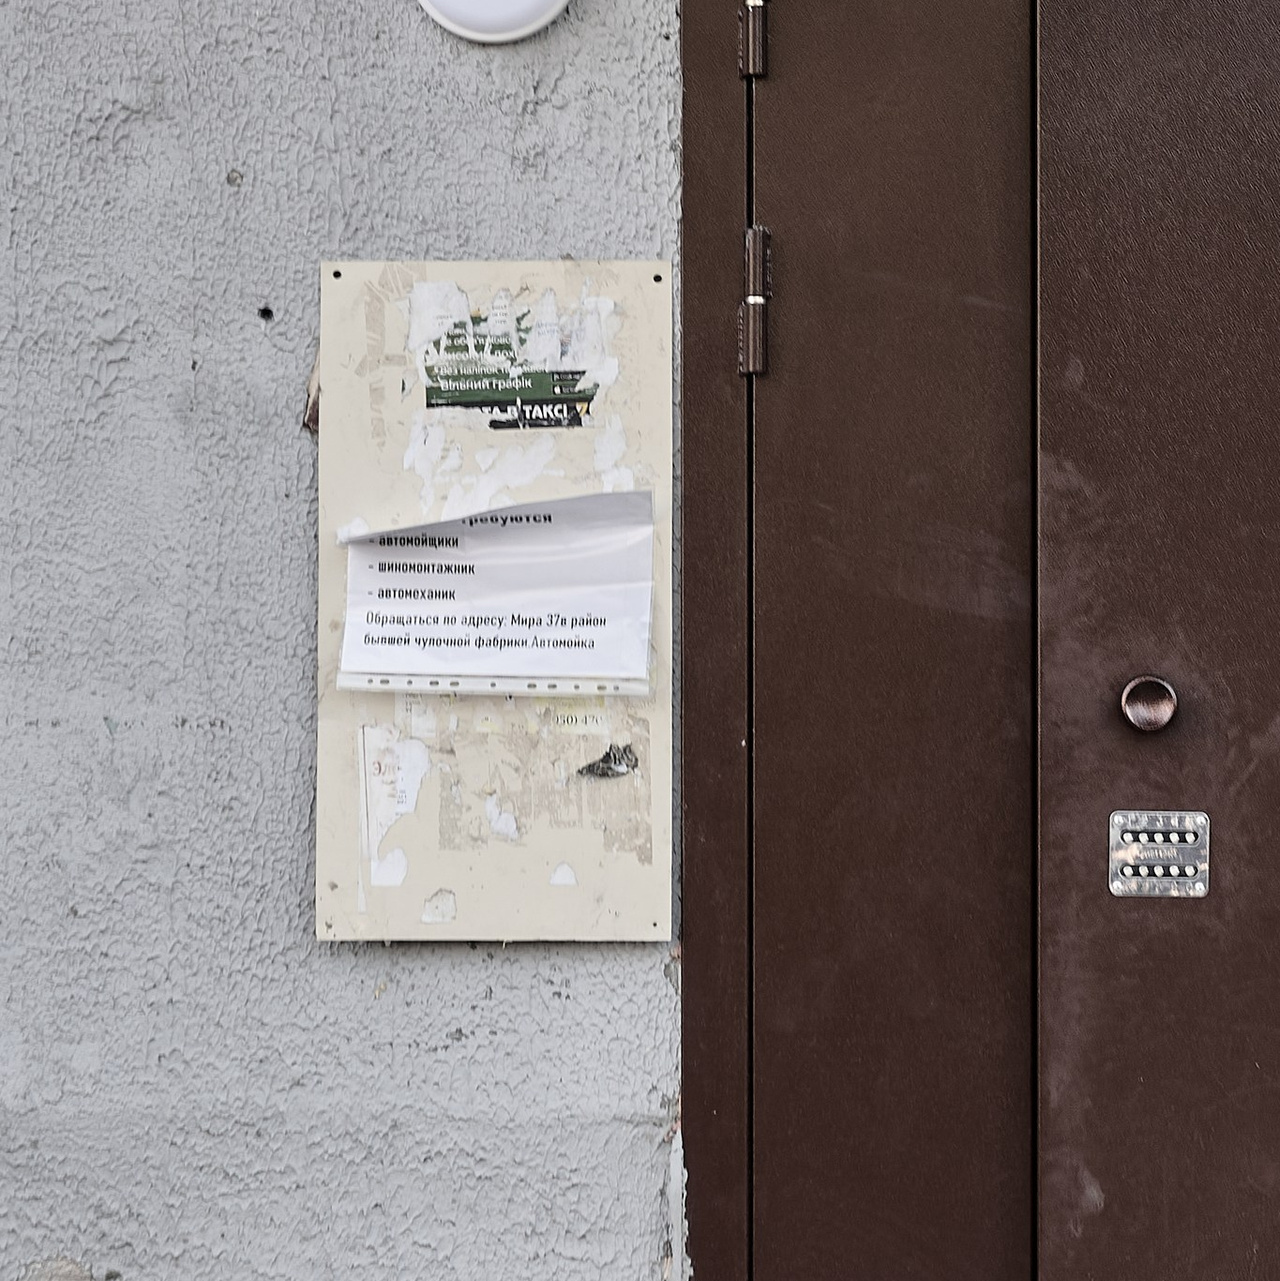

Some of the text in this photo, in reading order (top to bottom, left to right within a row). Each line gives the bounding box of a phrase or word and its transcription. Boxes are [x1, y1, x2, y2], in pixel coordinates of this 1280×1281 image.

[379, 533, 459, 549] автомойщики
[378, 562, 475, 575] шиномонтажник
[378, 588, 456, 600] автомеханик
[366, 610, 439, 628] Обращаться
[443, 616, 457, 626] по
[510, 613, 542, 630] Мира
[571, 612, 607, 629] район
[364, 632, 410, 646] бывшей
[414, 633, 471, 650] чулочной
